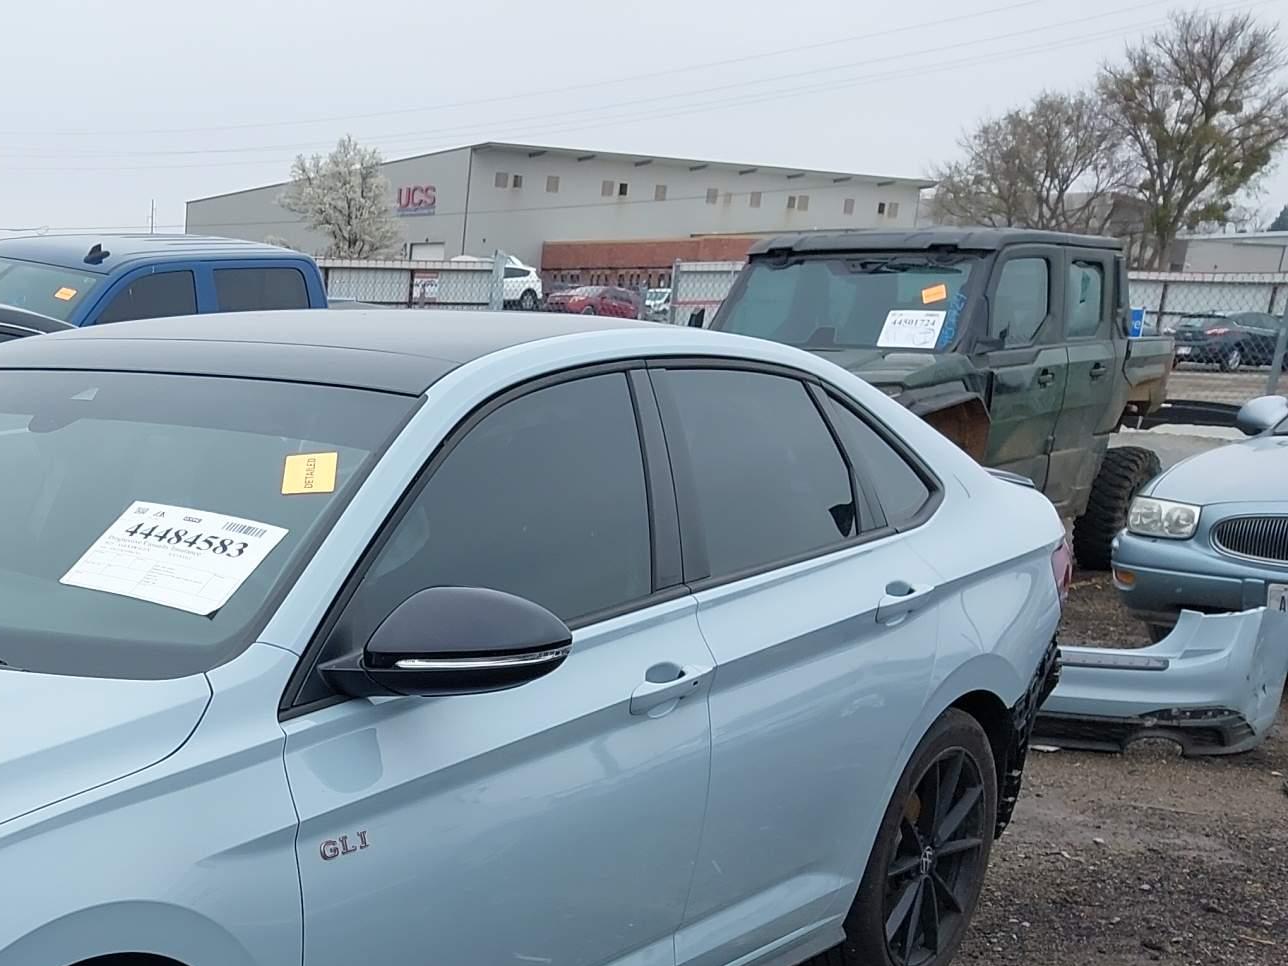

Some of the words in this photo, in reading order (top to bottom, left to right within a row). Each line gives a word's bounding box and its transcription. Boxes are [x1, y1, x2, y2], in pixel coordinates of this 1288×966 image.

[397, 186, 436, 208] UCS
[891, 319, 936, 327] 44501724
[303, 457, 316, 489] DETAILED
[124, 522, 249, 558] 44484583
[319, 830, 371, 861] GLI
